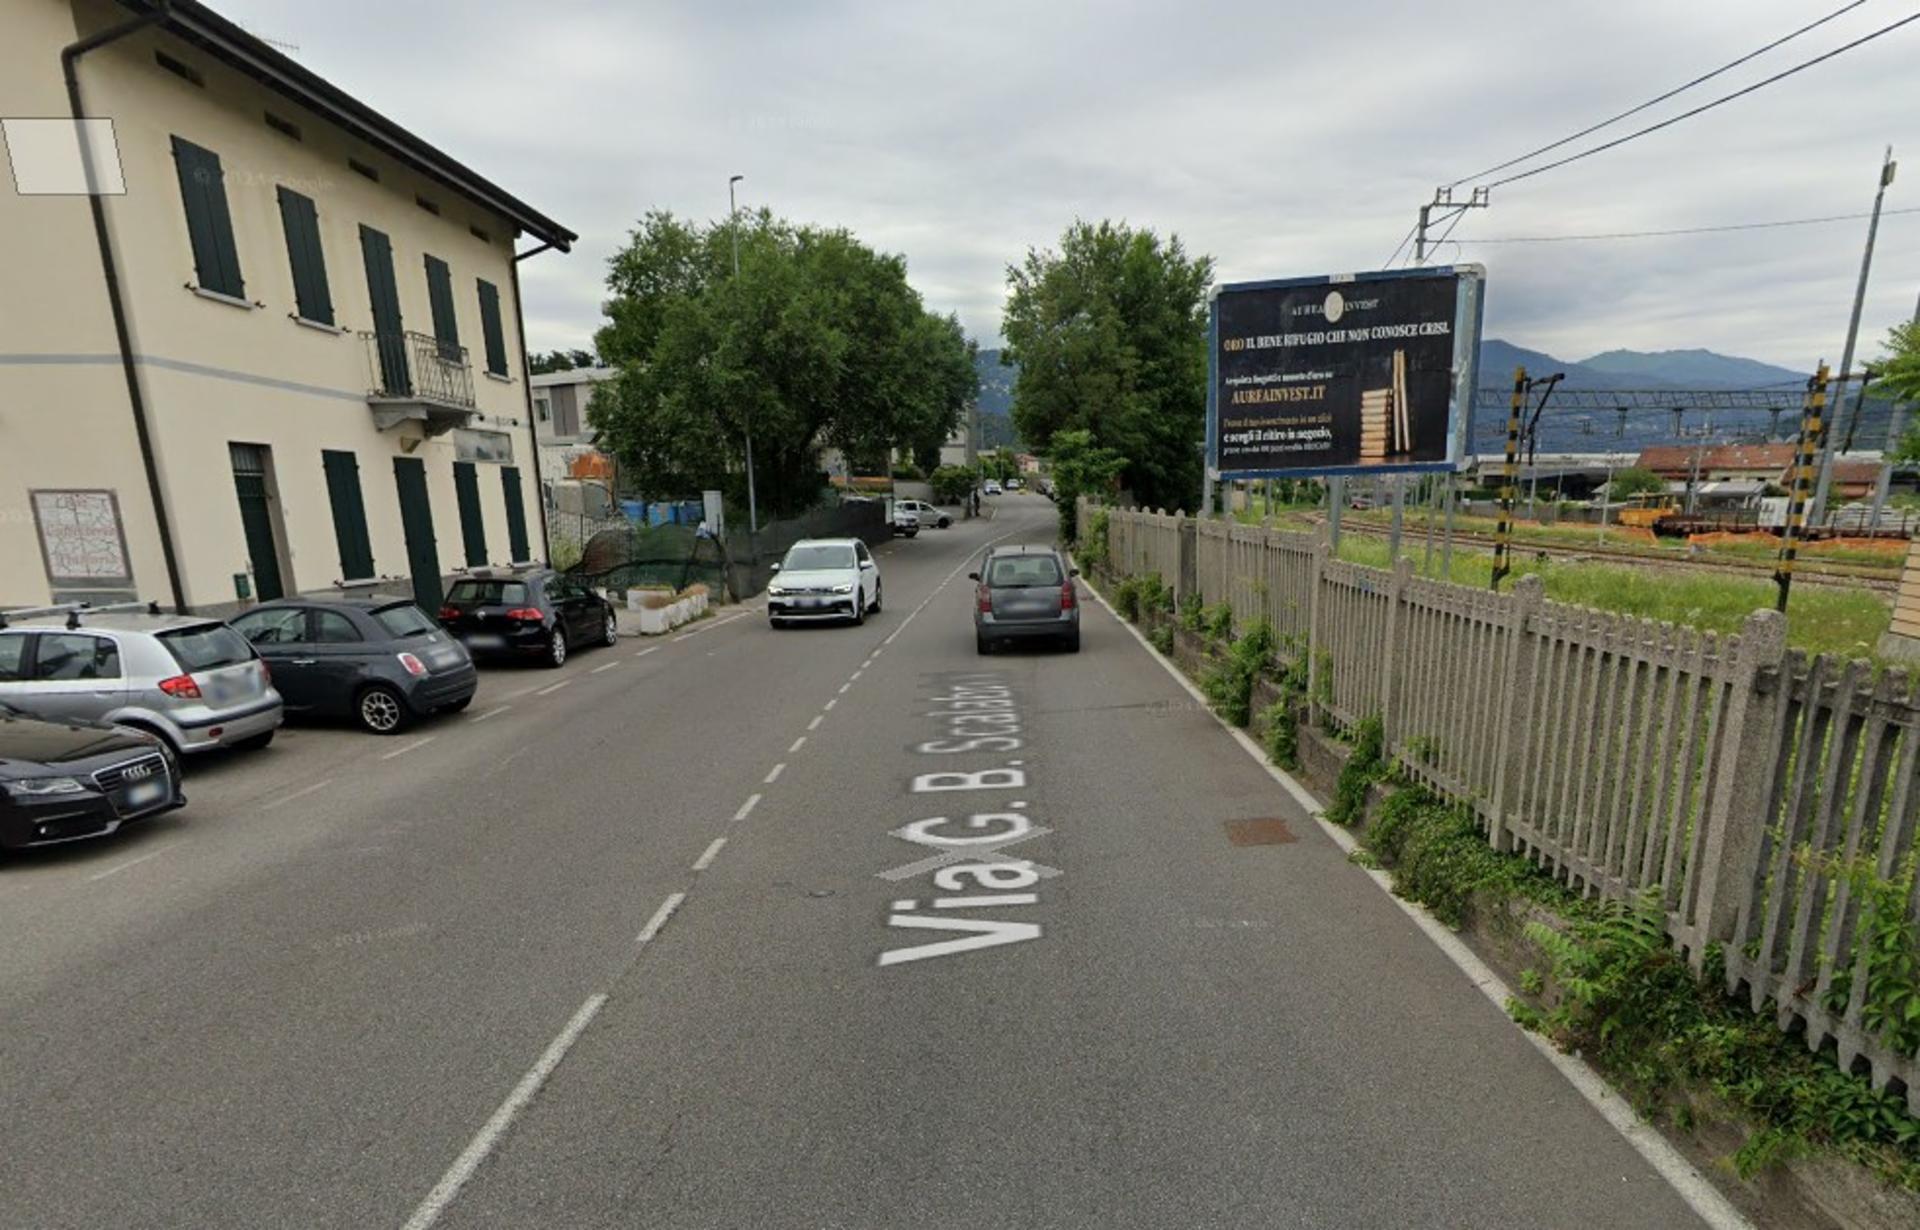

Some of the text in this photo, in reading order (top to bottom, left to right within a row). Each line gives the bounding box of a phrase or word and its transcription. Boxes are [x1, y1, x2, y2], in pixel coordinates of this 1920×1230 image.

[1256, 334, 1283, 349] BENE
[1284, 331, 1325, 347] RIFUGIO
[1326, 328, 1346, 344] CHE
[1347, 327, 1370, 342] NON
[1371, 323, 1418, 340] CONOSCE
